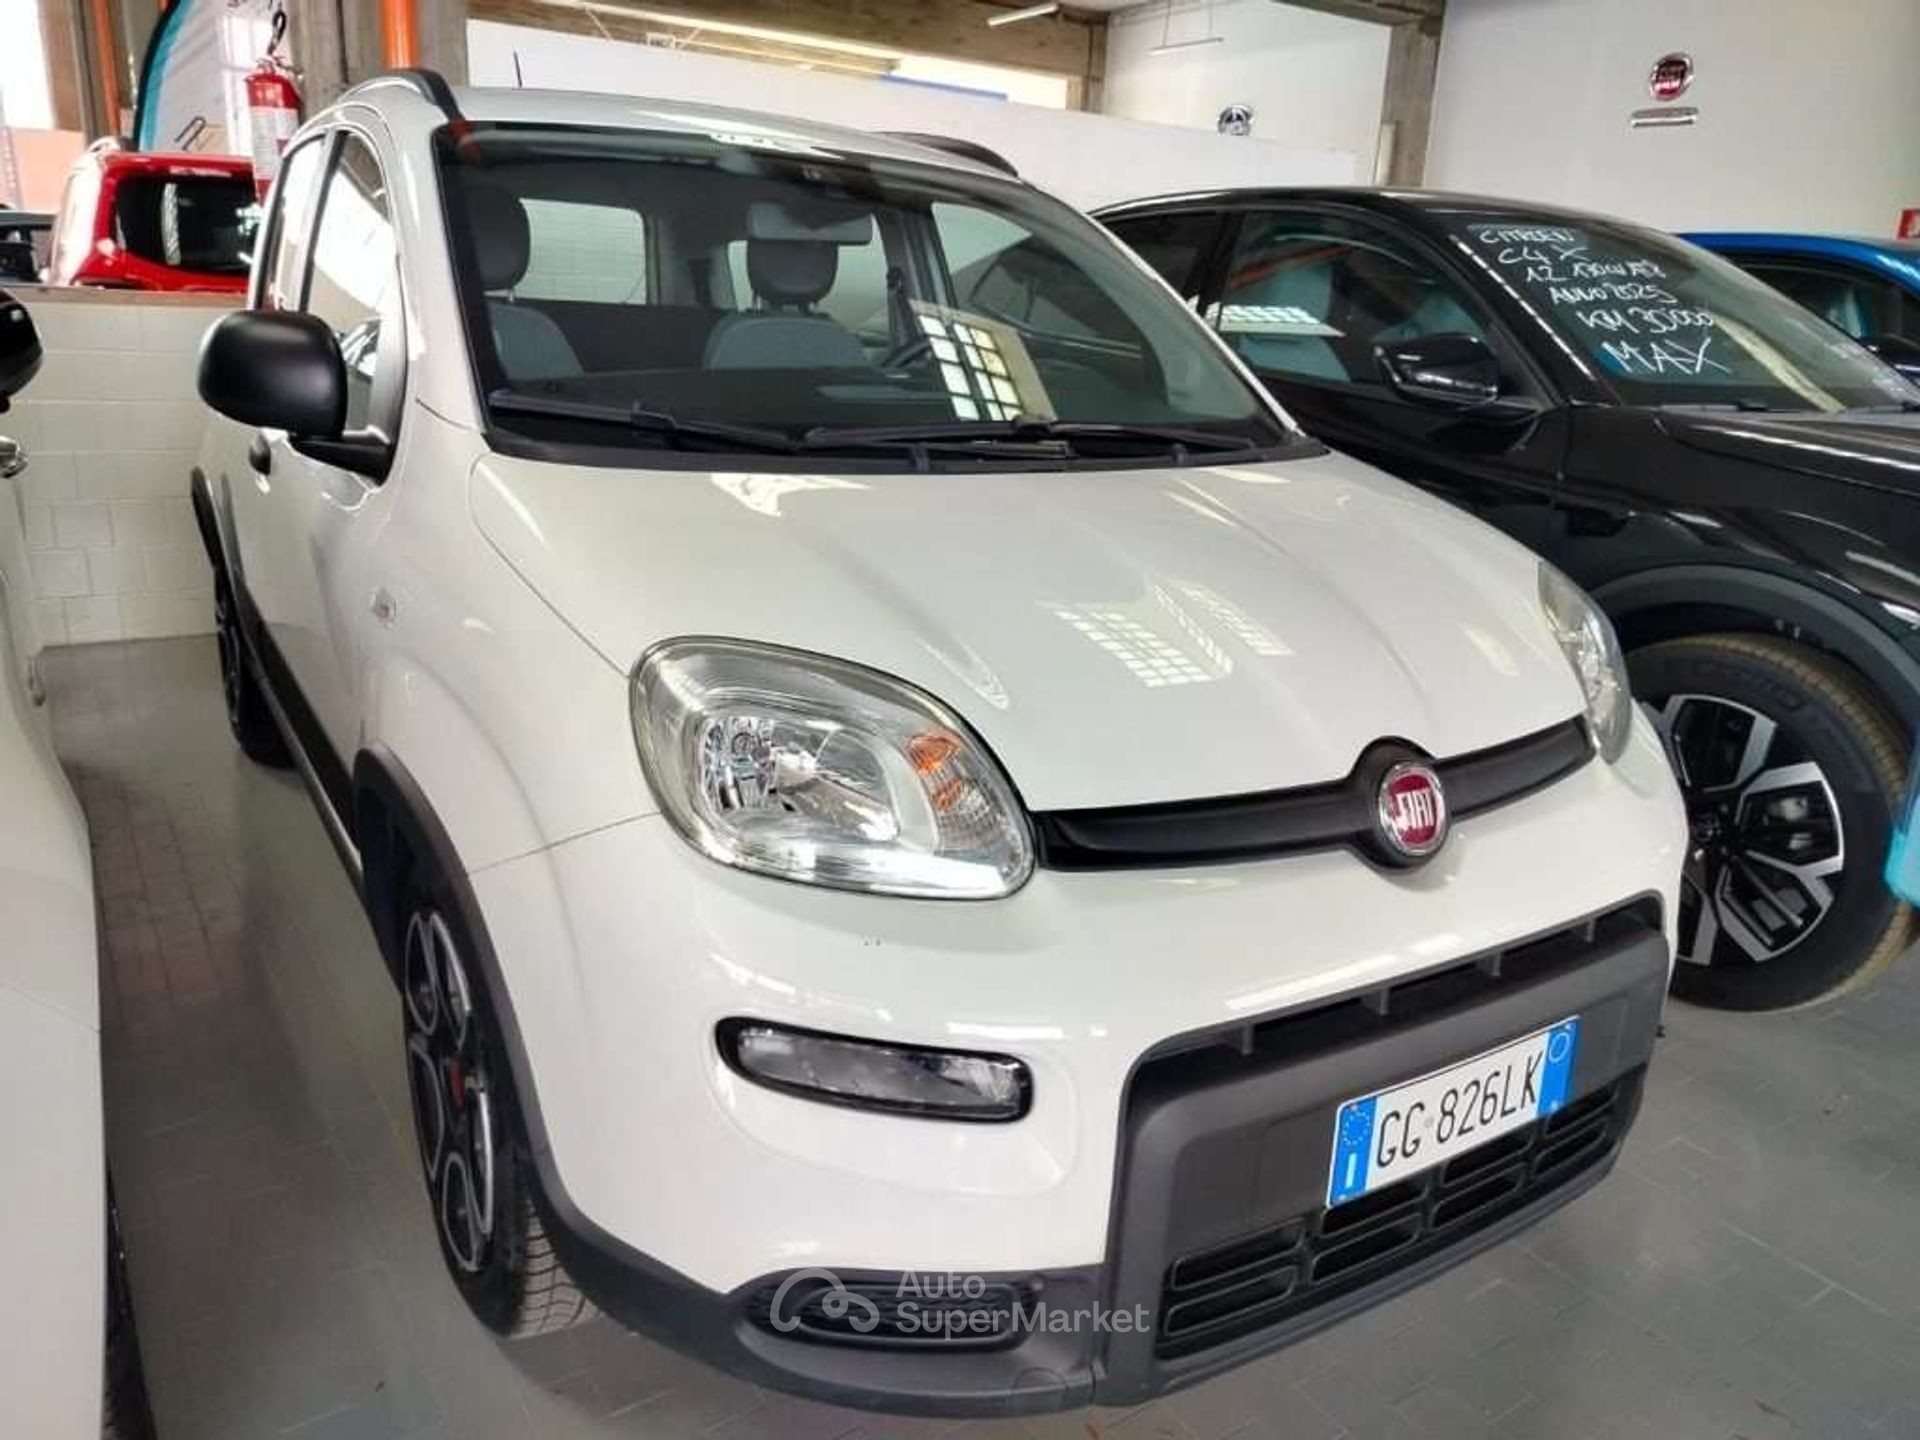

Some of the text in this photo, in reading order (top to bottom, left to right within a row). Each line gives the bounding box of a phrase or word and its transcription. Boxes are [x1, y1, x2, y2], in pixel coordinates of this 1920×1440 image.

[1498, 246, 1551, 265] C4
[1576, 308, 1640, 334] KM
[1602, 337, 1732, 374] MAX
[1394, 787, 1435, 832] FIAT
[1376, 1050, 1544, 1169] GG 826LK
